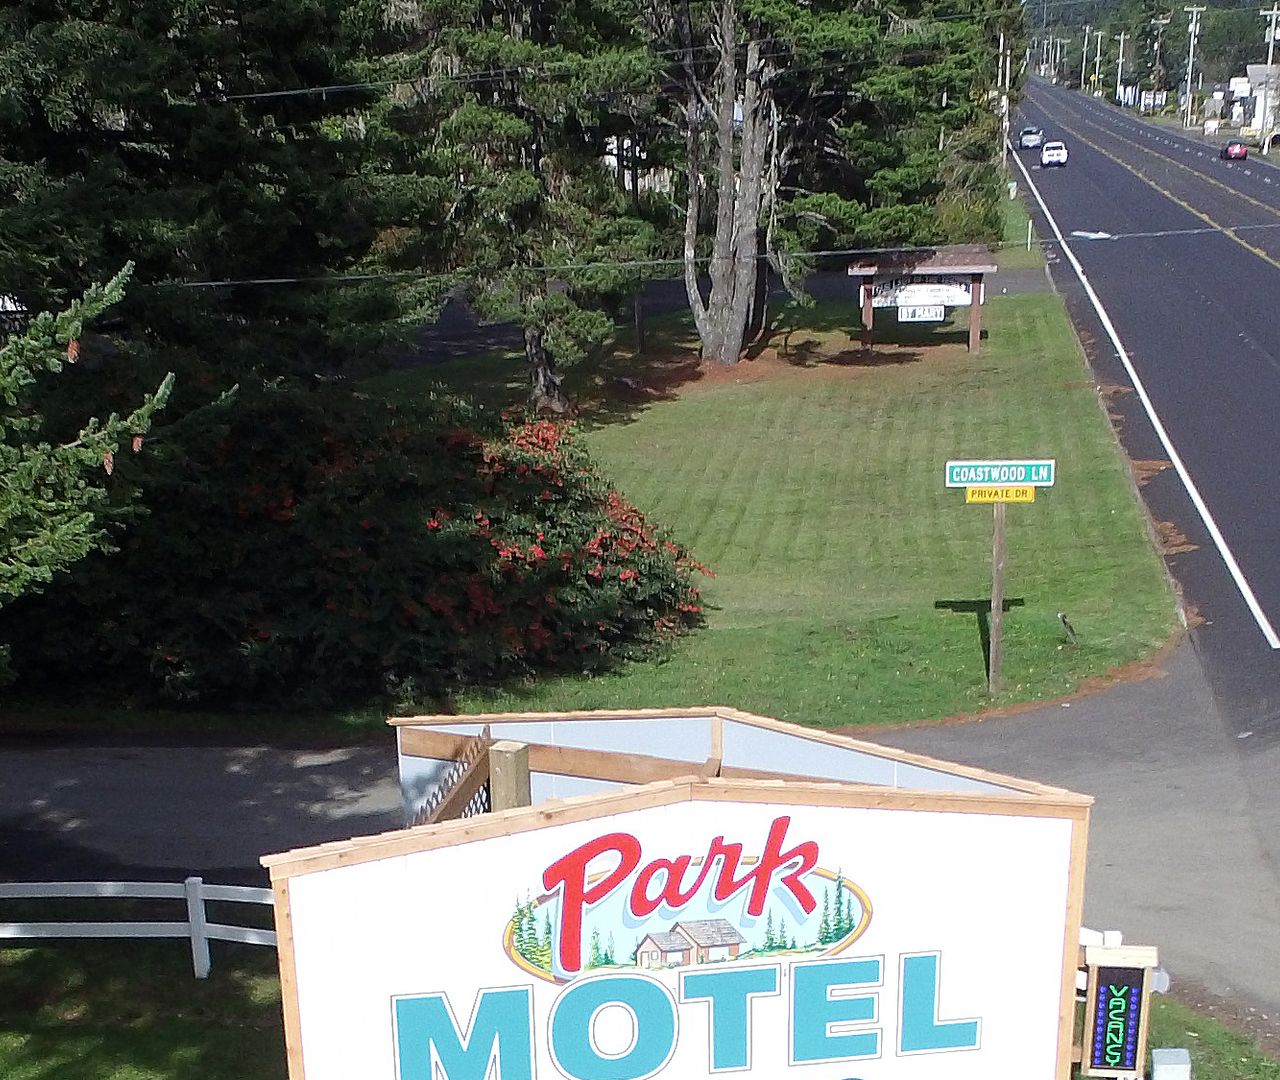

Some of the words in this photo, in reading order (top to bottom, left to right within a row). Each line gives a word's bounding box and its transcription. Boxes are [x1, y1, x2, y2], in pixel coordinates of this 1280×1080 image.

[952, 466, 1026, 482] COASTWOOD
[1031, 466, 1049, 481] LN
[971, 489, 1010, 499] PRIVATE
[1015, 489, 1028, 498] DR
[543, 816, 821, 973] Park
[1105, 984, 1129, 1067] VACANCY
